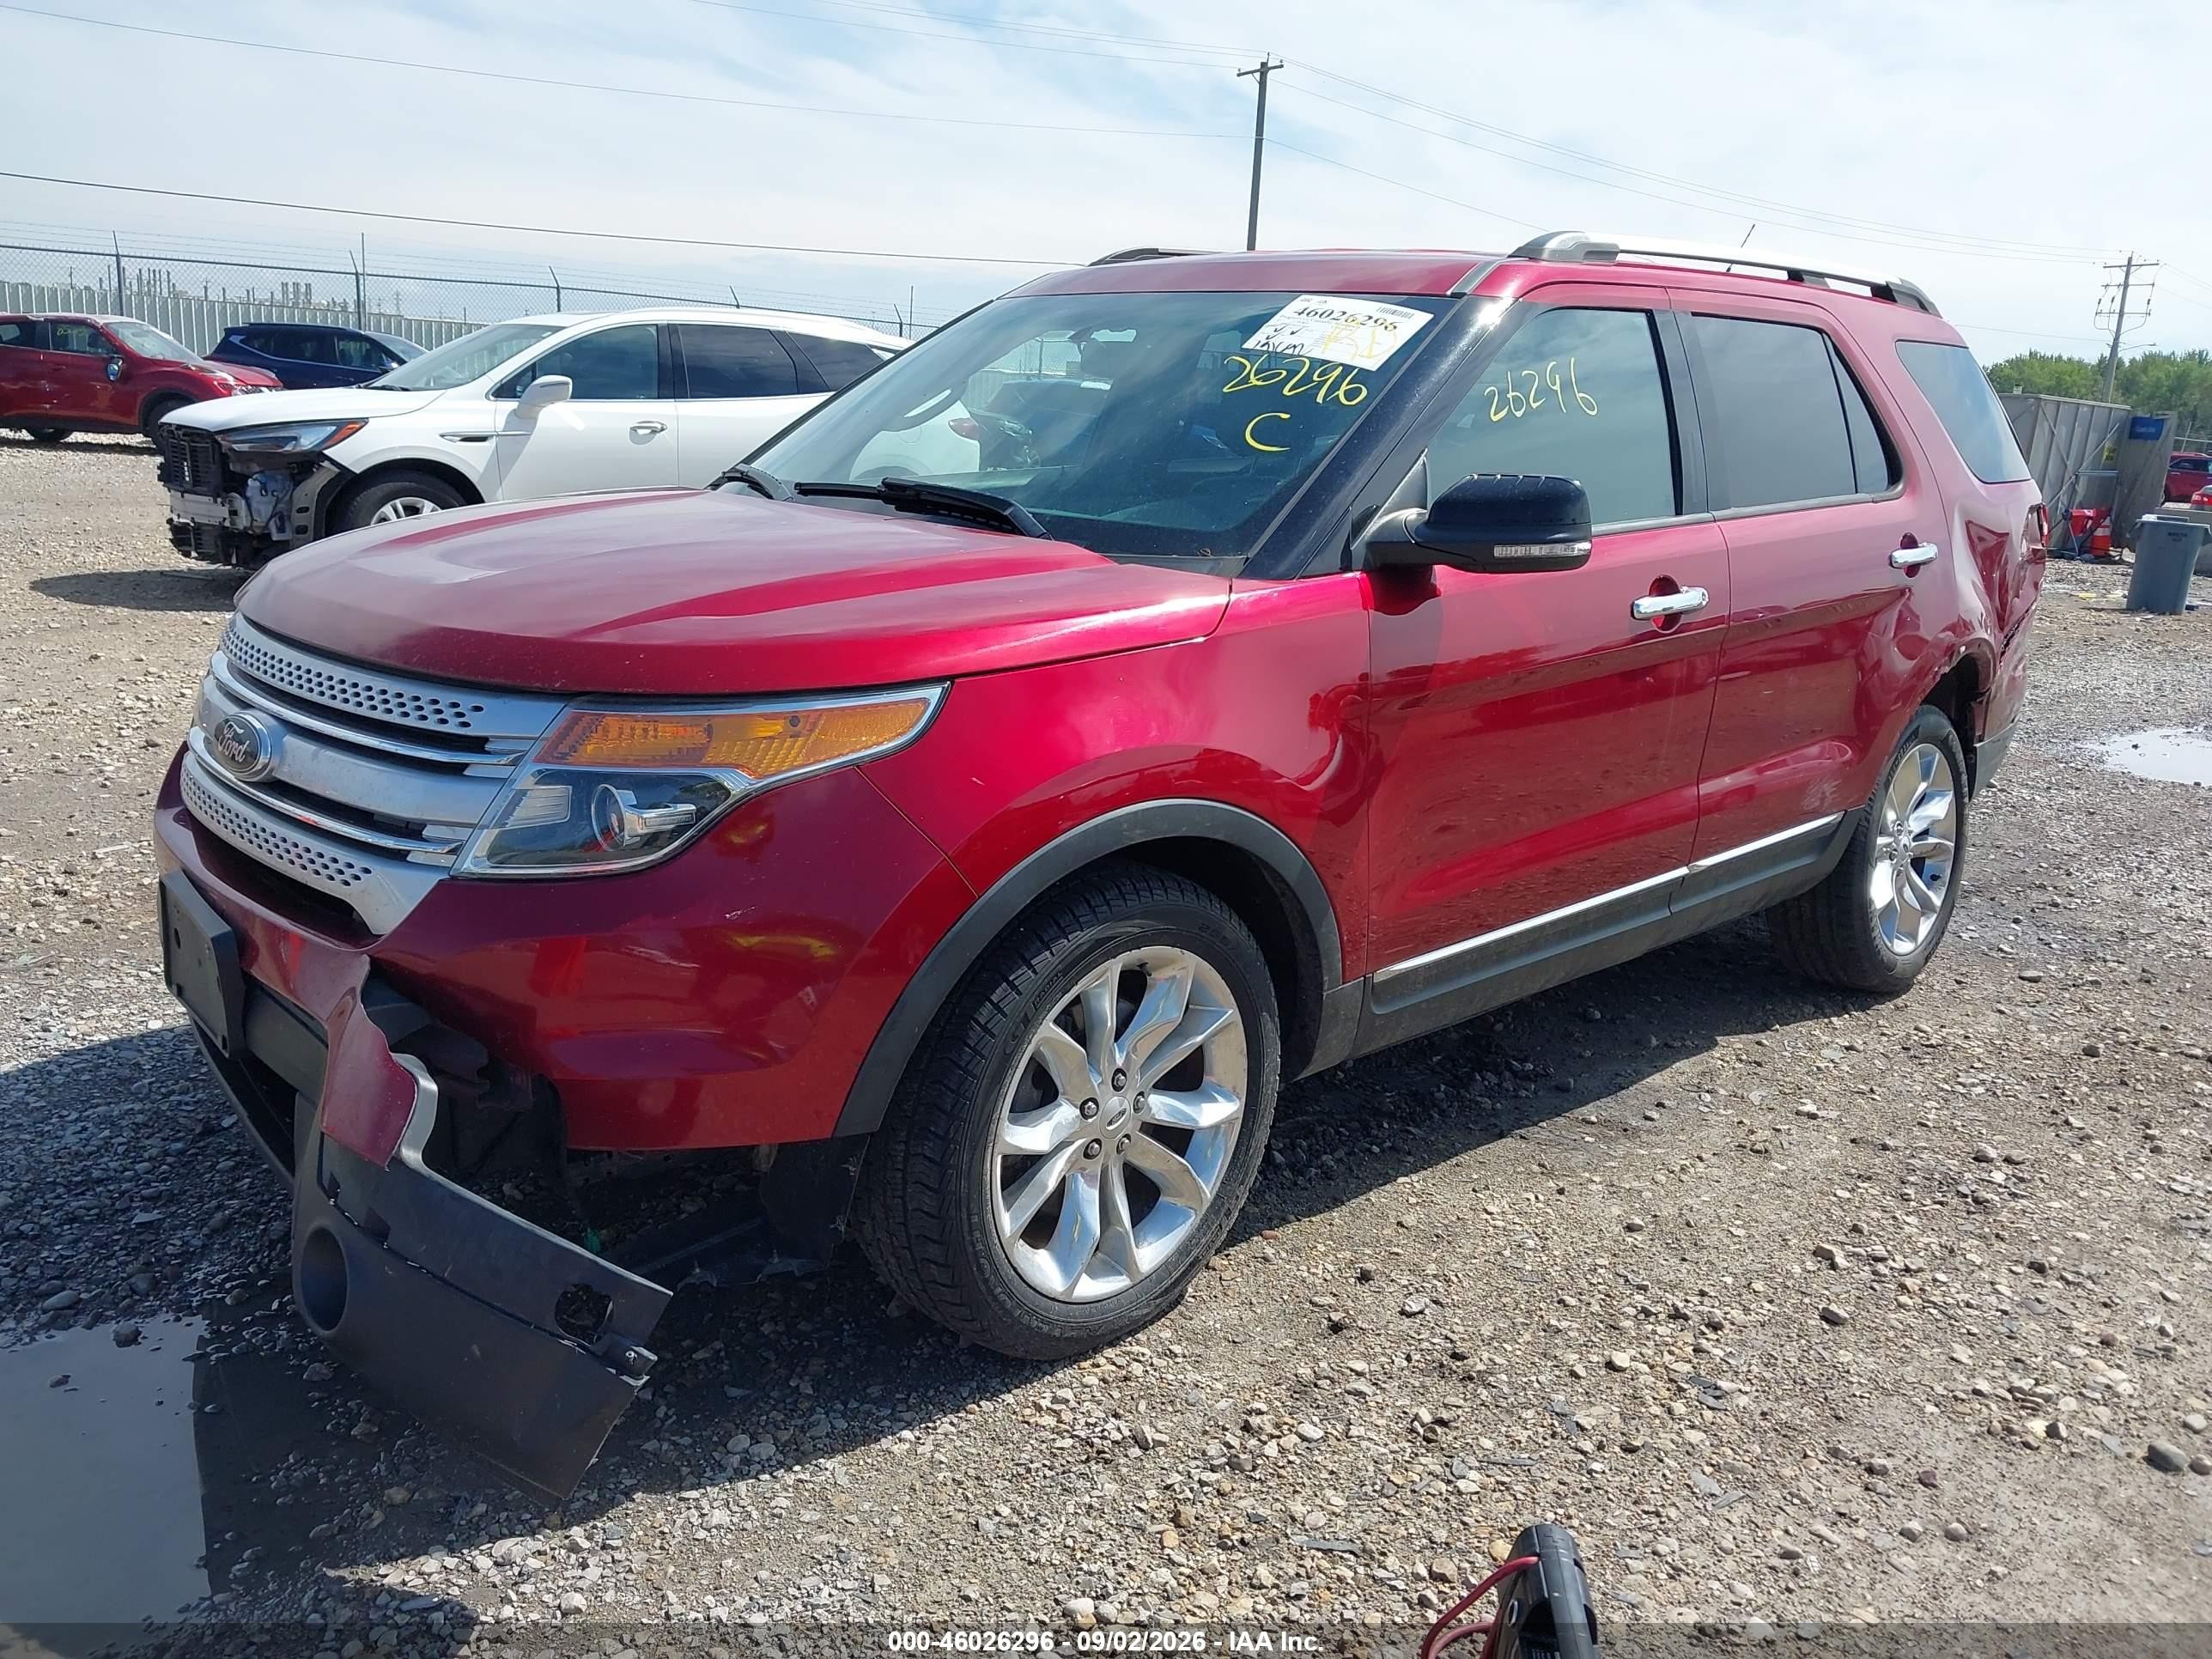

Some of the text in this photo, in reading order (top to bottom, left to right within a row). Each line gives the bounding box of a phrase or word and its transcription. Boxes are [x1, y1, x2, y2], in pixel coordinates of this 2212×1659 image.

[1294, 307, 1402, 331] 46026296
[1223, 353, 1367, 404] 26296
[1484, 357, 1597, 422] 26296
[1245, 412, 1291, 451] C
[218, 721, 250, 763] Ford
